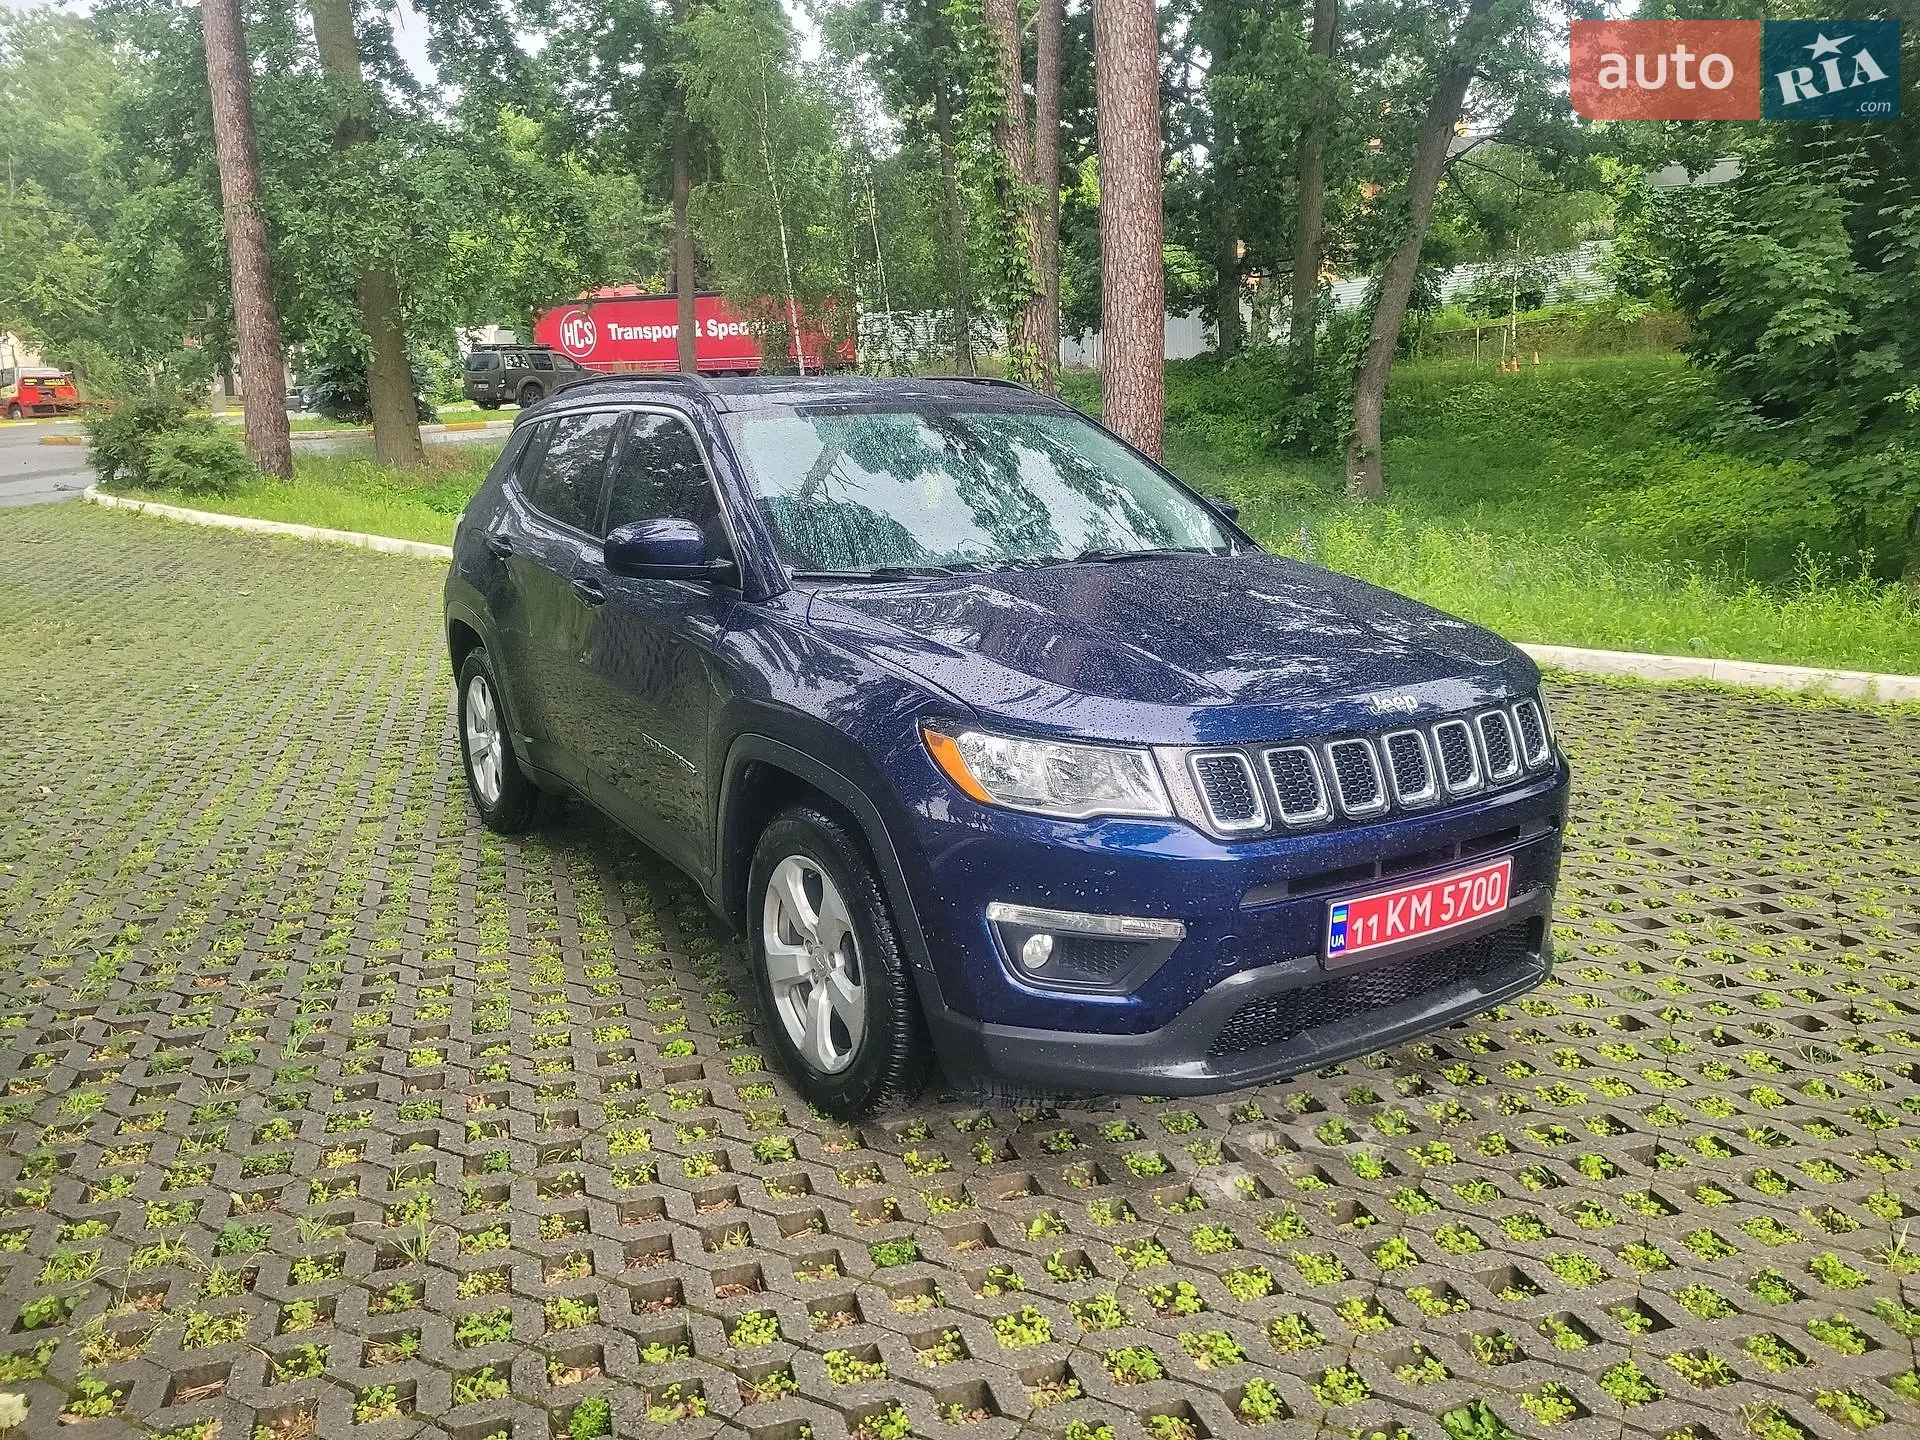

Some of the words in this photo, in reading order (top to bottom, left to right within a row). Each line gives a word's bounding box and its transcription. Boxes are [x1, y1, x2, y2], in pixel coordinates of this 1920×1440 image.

[563, 319, 594, 349] HCS
[607, 323, 680, 342] Transpor
[1368, 695, 1419, 716] Jeep
[1440, 871, 1502, 922] 5700
[1330, 933, 1345, 948] UA
